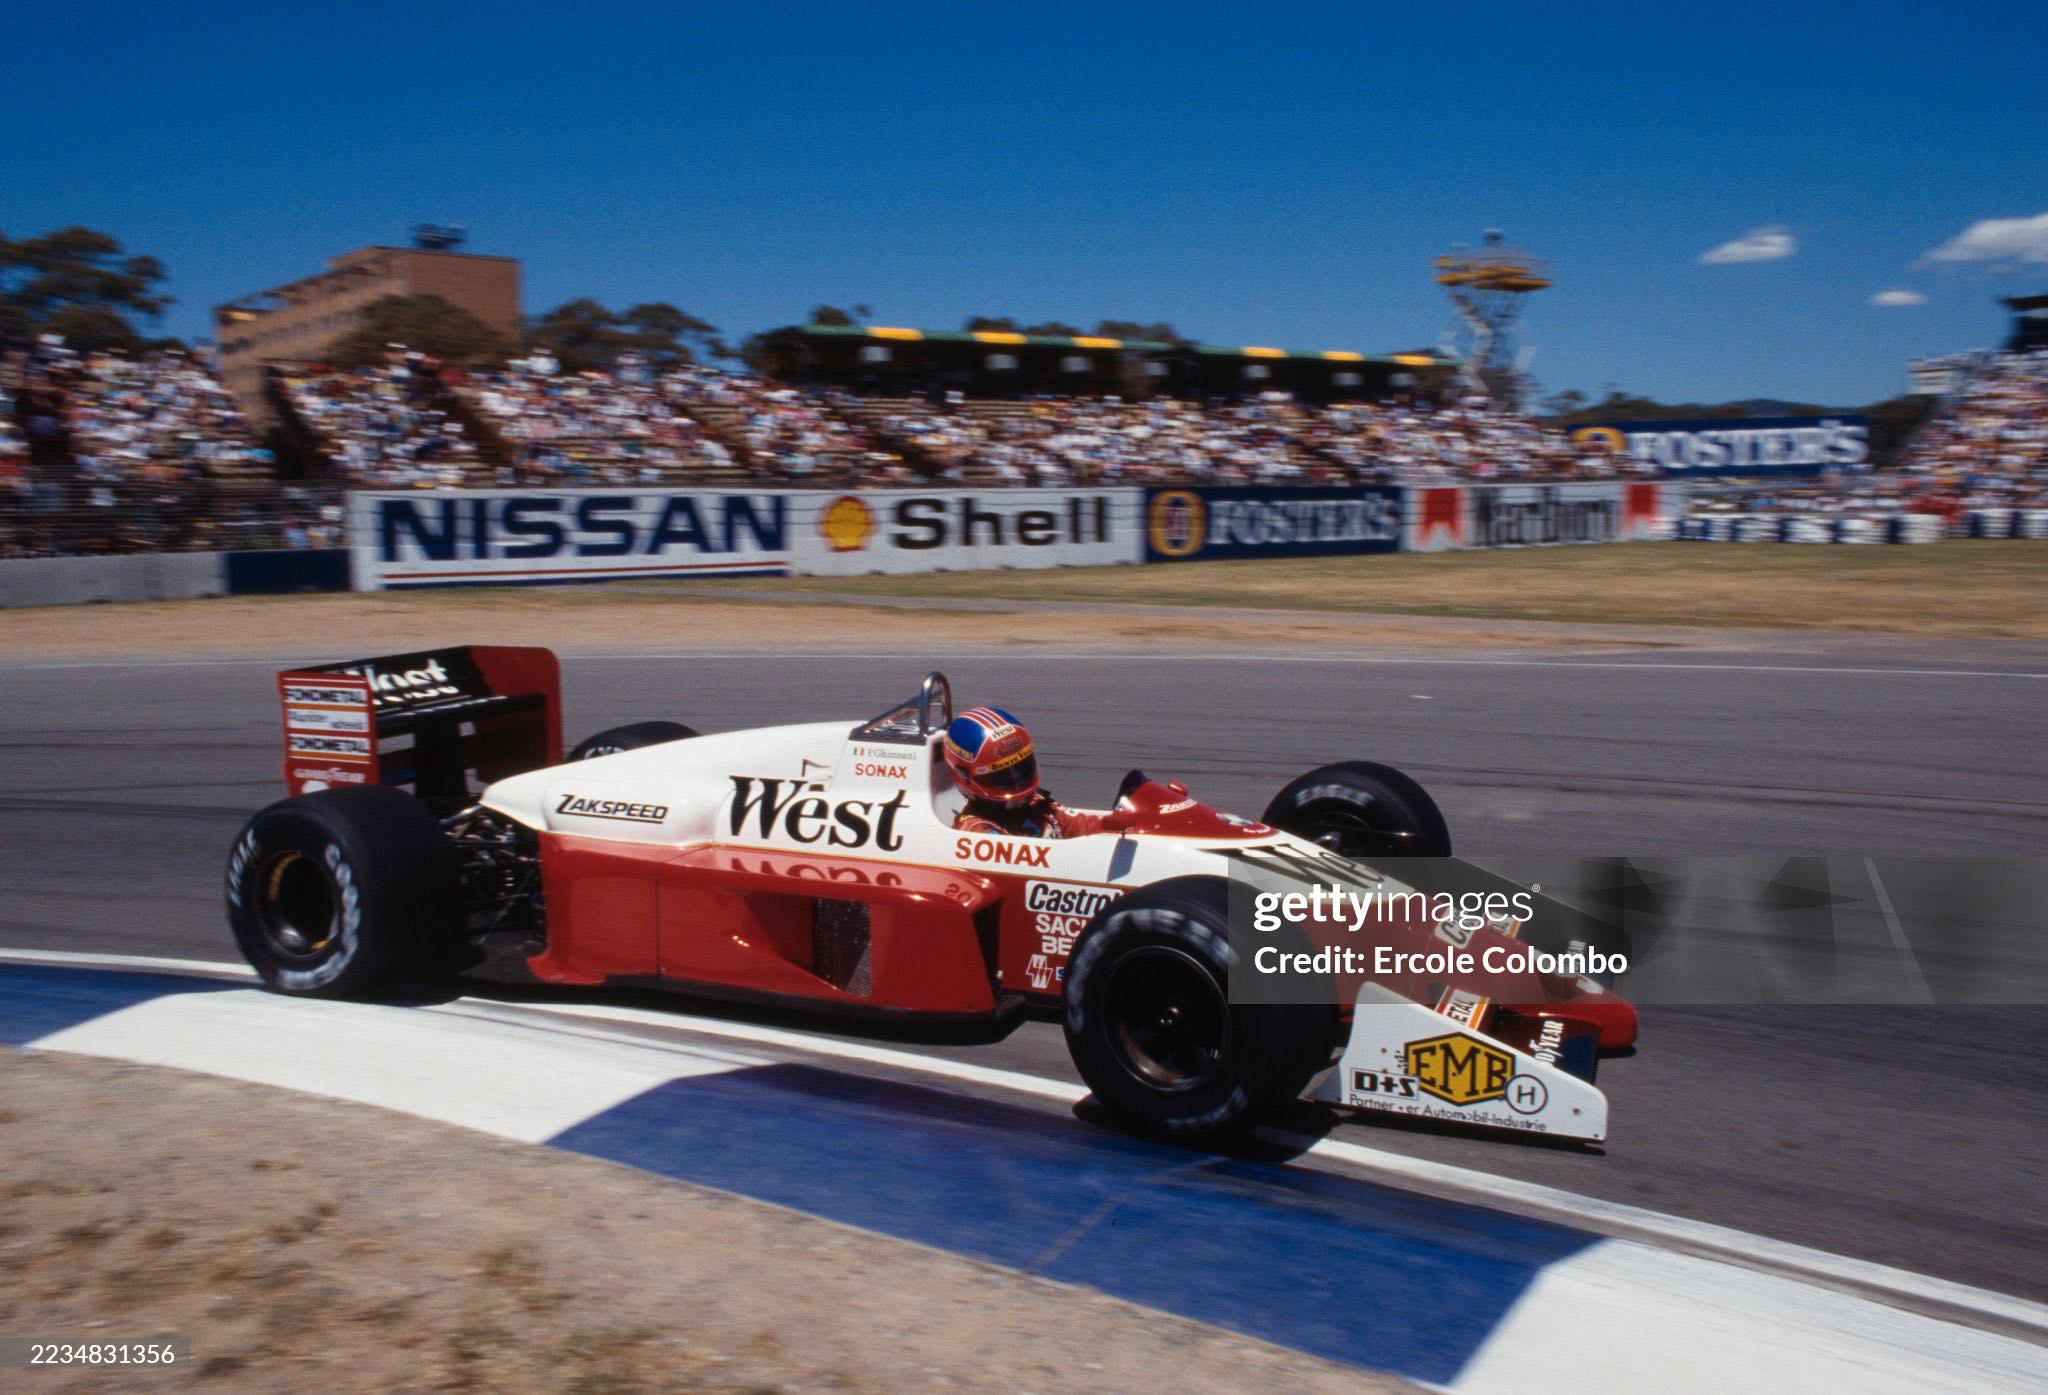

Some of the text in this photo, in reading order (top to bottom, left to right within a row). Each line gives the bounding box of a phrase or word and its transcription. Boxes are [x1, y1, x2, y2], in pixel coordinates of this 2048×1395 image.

[1625, 419, 1868, 468] FOSTER'S
[381, 496, 786, 561] NISSAN
[891, 497, 1109, 549] Shell
[1207, 493, 1398, 544] FOSTER'S
[855, 763, 907, 778] SONAX
[556, 794, 668, 822] ZAKSPEED
[729, 775, 910, 851] West
[955, 837, 1052, 869] SONAX
[1412, 1043, 1509, 1096] EMB
[1350, 1094, 1393, 1111] Partner
